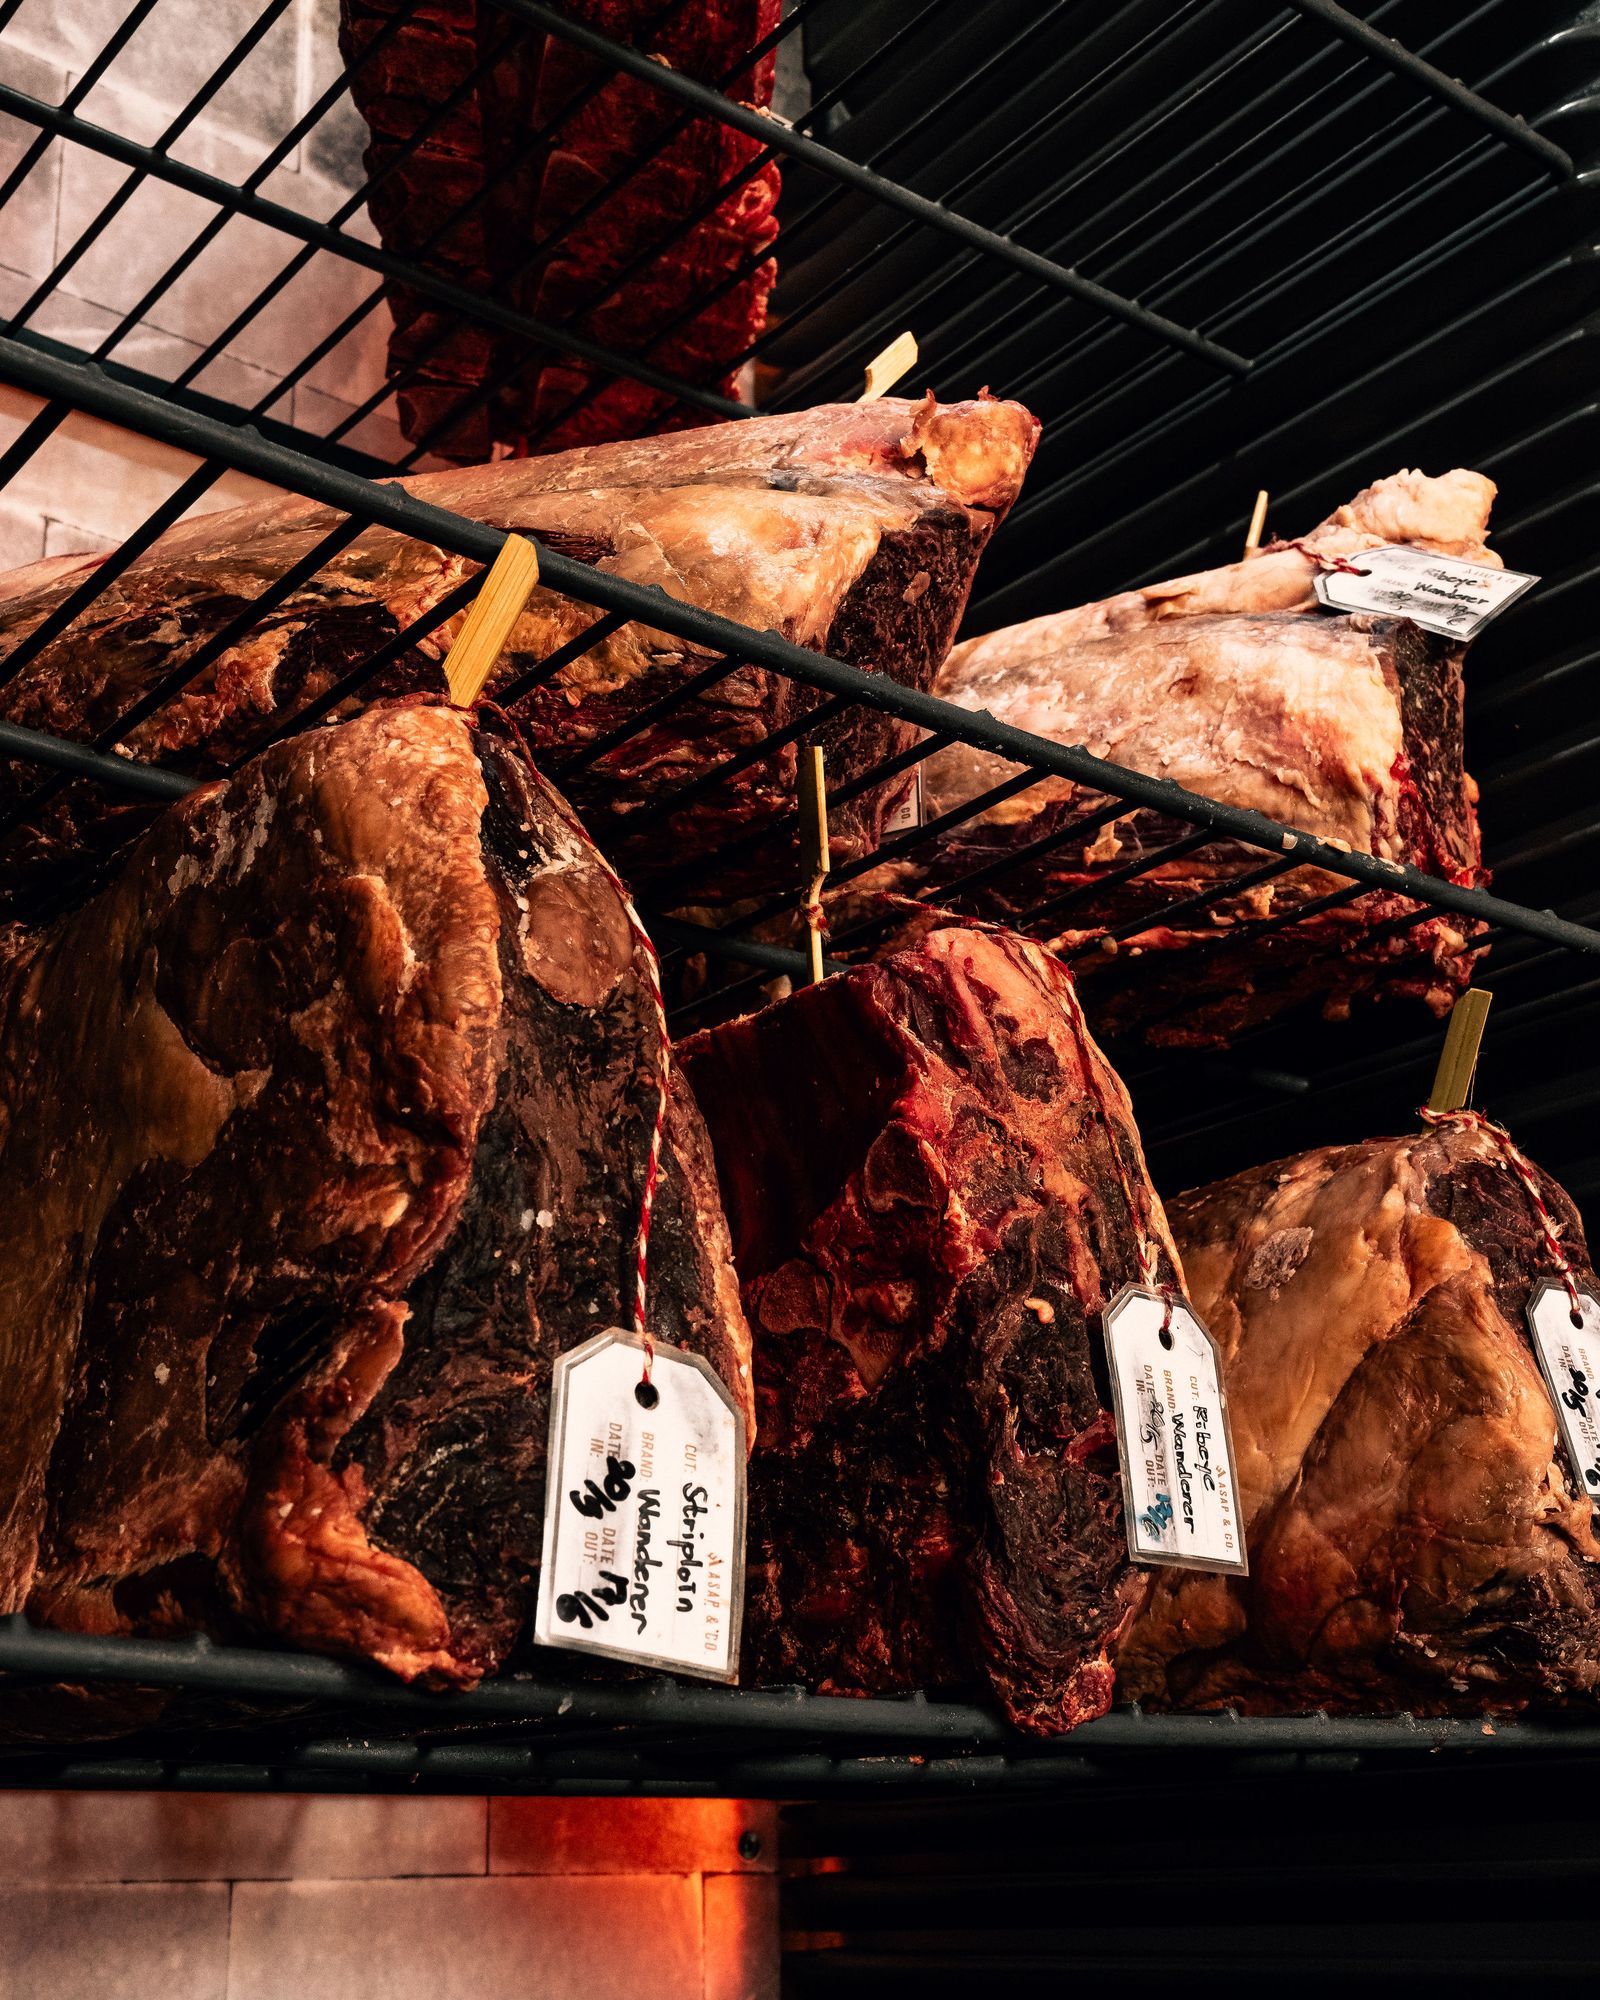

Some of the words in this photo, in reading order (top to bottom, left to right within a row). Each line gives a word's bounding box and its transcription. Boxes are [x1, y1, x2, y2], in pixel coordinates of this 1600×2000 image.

[1413, 581, 1491, 606] Wanderer
[1557, 1357, 1569, 1373] IN:
[1561, 1345, 1576, 1372] DATE
[1578, 1347, 1596, 1383] BRAND:
[1135, 1378, 1145, 1396] IN:
[1143, 1363, 1156, 1395] DATE
[1189, 1375, 1200, 1401] CUT:
[607, 1421, 623, 1460] DATE
[1578, 1421, 1590, 1445] OUT:
[1585, 1417, 1599, 1442] DATE
[589, 1437, 604, 1458] IN:
[639, 1430, 656, 1483] BRAND:
[684, 1443, 698, 1474] CUT:
[1162, 1368, 1177, 1414] BRAND:
[1171, 1412, 1196, 1535] Wanderer
[1192, 1404, 1217, 1493] Ribeye
[1145, 1459, 1156, 1489] OUT:
[1154, 1453, 1168, 1487] DATE
[1217, 1481, 1230, 1514] ASAP
[1222, 1517, 1232, 1527] &
[582, 1530, 599, 1564] OUT:
[600, 1526, 617, 1566] DATE
[1225, 1532, 1235, 1553] CO.
[630, 1488, 664, 1636] Wanderer
[704, 1571, 722, 1609] ASAP
[705, 1613, 720, 1625] &
